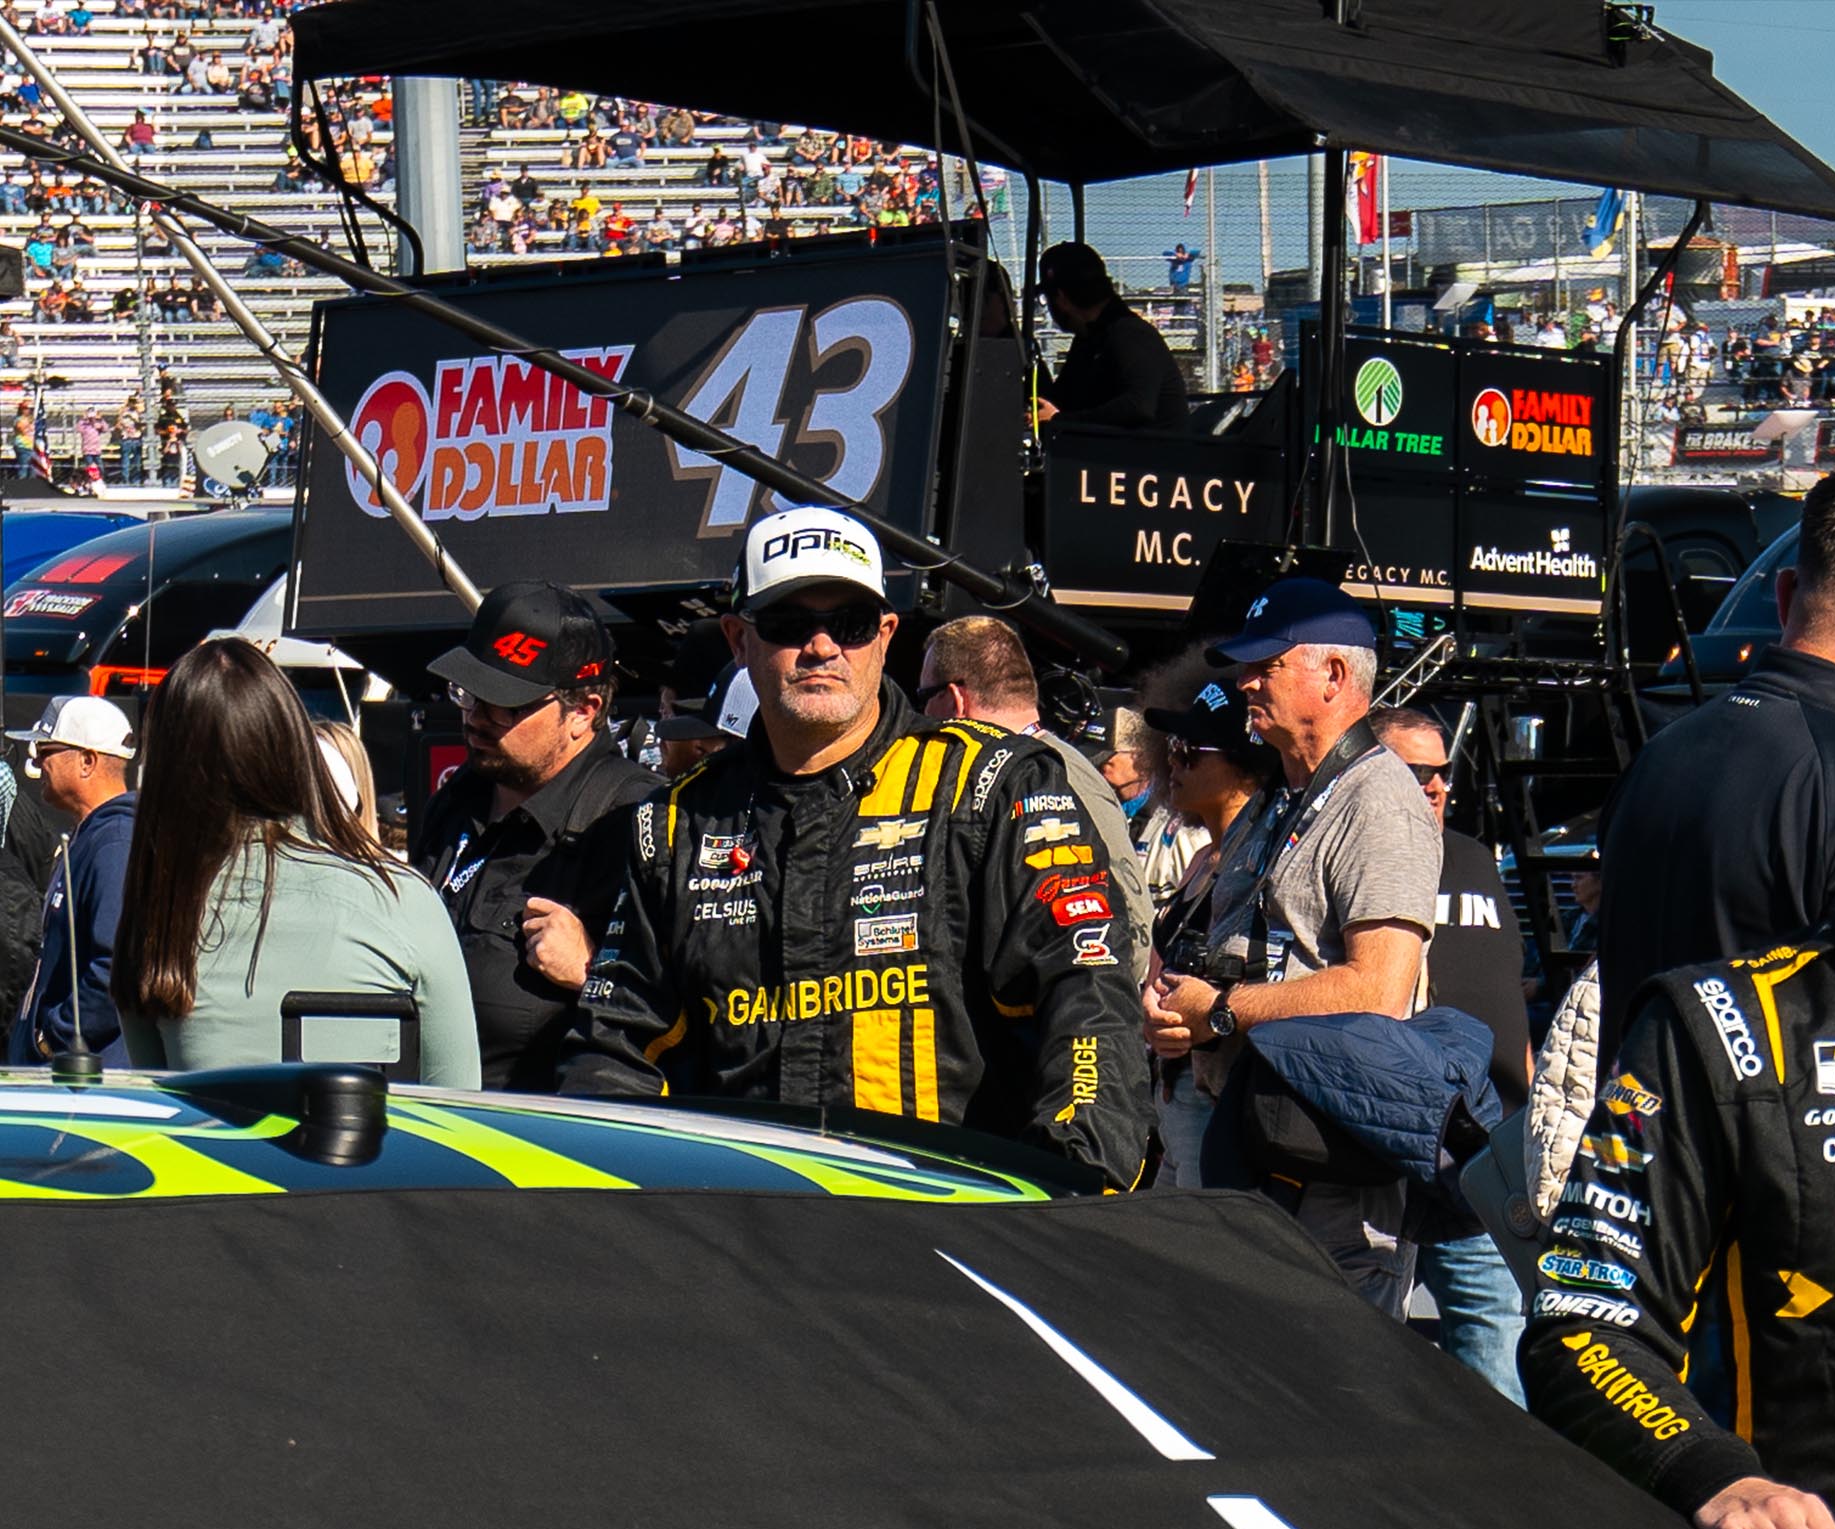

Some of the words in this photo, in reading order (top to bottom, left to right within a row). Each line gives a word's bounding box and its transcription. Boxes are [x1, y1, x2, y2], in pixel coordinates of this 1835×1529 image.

[436, 351, 624, 438] FAMILY
[672, 297, 912, 530] 43
[1511, 388, 1594, 426] FAMILY
[1395, 431, 1444, 455] TREE
[1511, 422, 1593, 456] DOLLAR
[431, 436, 608, 511] DOLLAR
[1081, 469, 1255, 514] LEGACY
[1134, 529, 1201, 566] M.C.
[1470, 545, 1597, 578] AdventHealth
[493, 631, 548, 667] 45
[971, 748, 1013, 813] sparco
[1028, 794, 1076, 813] NASCAR
[637, 801, 655, 861] sparco
[1065, 899, 1104, 918] SEM
[727, 963, 930, 1026] GAINBRIDGE
[1693, 976, 1763, 1082] sparco
[1542, 1254, 1582, 1278] STAR
[1533, 1289, 1640, 1327] COMETIC
